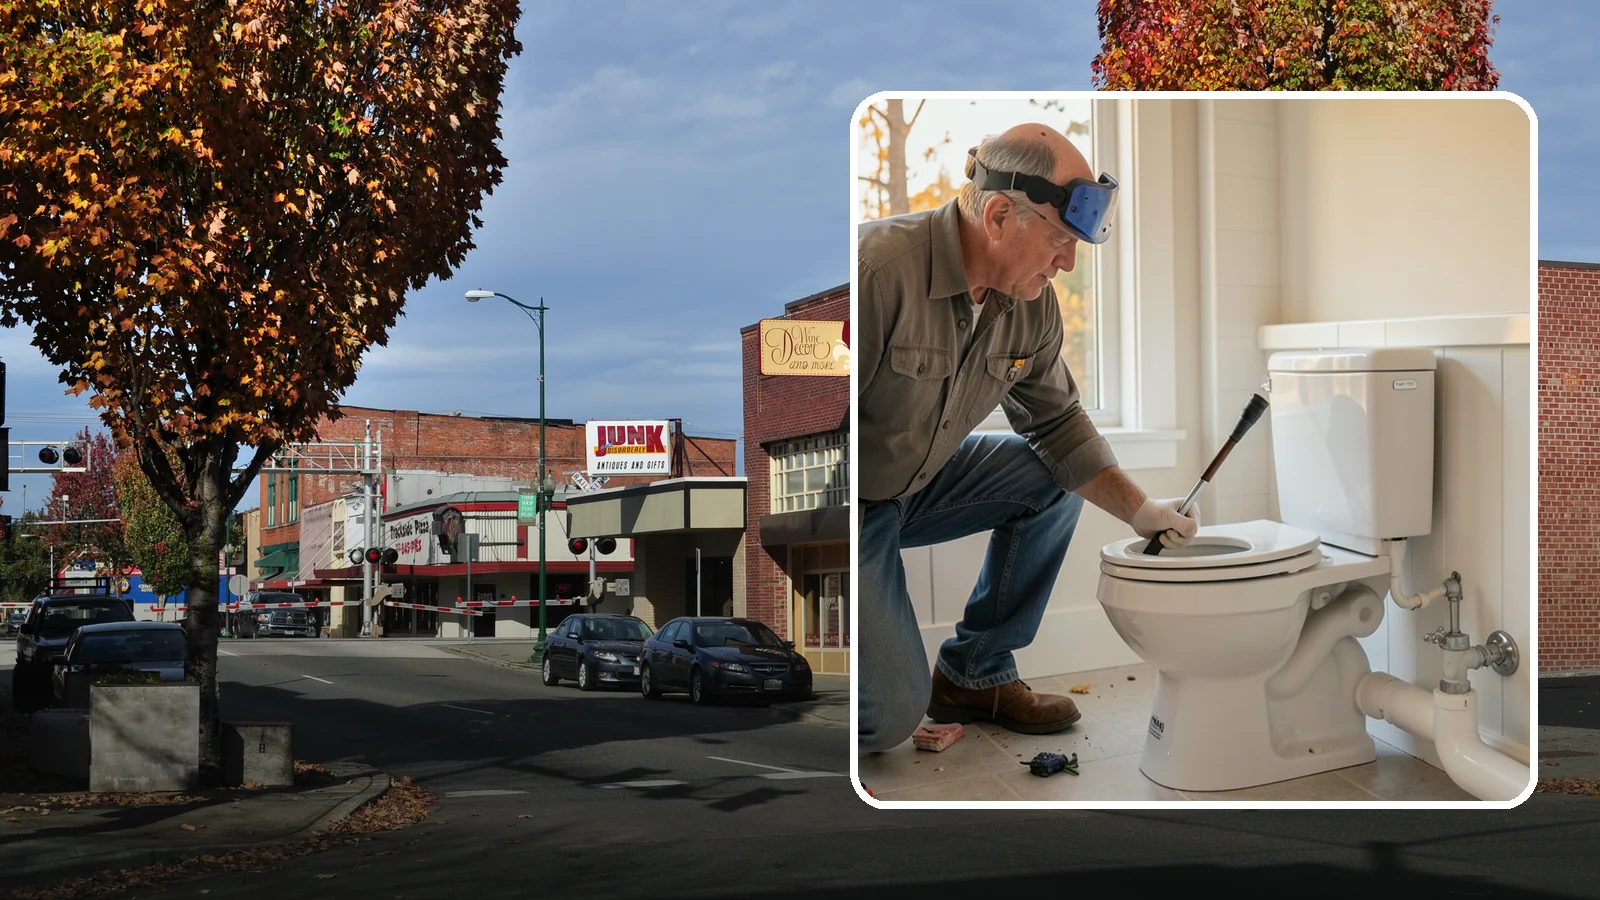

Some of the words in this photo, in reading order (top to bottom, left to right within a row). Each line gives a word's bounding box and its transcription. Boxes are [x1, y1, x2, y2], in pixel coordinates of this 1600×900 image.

[595, 425, 665, 457] JUNK
[607, 446, 646, 454] DISORDERLY
[597, 461, 628, 470] ANTIQUES
[631, 461, 644, 470] AND
[646, 461, 665, 470] GIFTS
[414, 519, 429, 534] Pizza
